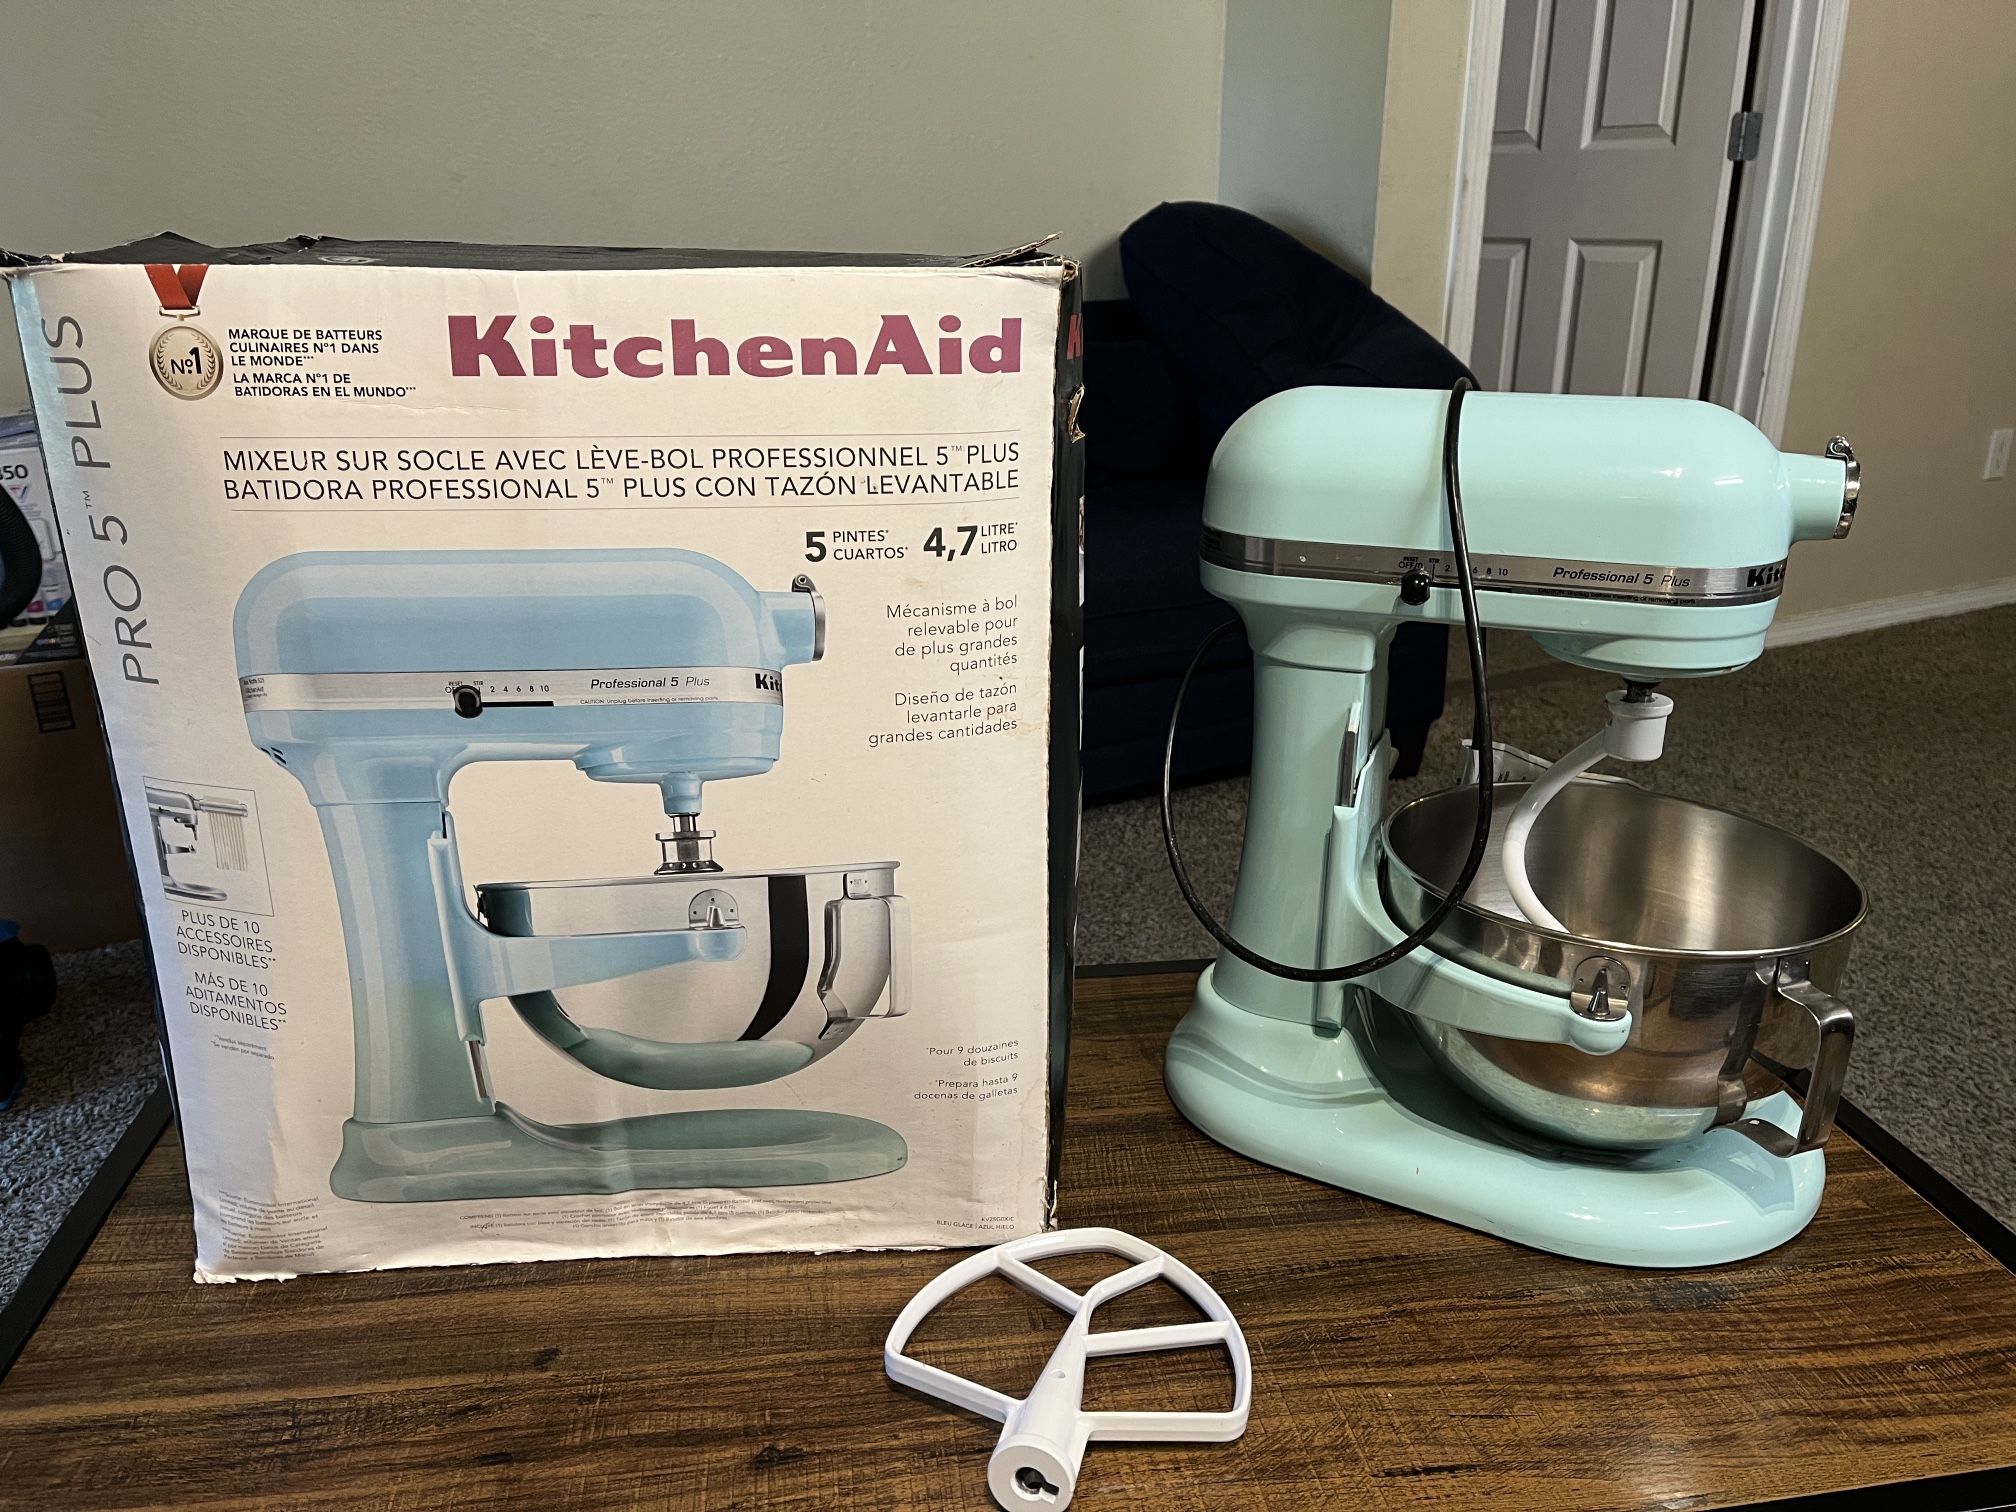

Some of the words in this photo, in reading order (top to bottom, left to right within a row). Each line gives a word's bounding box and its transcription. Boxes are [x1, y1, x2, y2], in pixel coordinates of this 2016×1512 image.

[228, 329, 289, 340] MARQUE
[294, 329, 312, 340] DE
[316, 329, 382, 341] BATTEURS
[229, 342, 309, 353] CULINAIRES
[341, 343, 379, 354] DANS
[447, 314, 1022, 379] KitchenAid
[231, 356, 246, 366] LE
[233, 373, 250, 383] LA
[252, 373, 301, 384] MARCA
[333, 374, 351, 384] DE
[41, 316, 111, 468] PLUS
[235, 386, 308, 397] BATIDORAS
[313, 387, 331, 397] EN
[335, 387, 350, 397] EL
[223, 450, 328, 471] MIXEUR
[337, 449, 389, 471] SUR
[397, 449, 485, 471] SOCLE
[495, 449, 567, 471] AVEC
[576, 444, 704, 470] LÈVE-BOL
[713, 446, 929, 470] PROFESSIONNEL
[967, 442, 1020, 463] PLUS
[223, 478, 364, 500] BATIDORA
[372, 478, 578, 500] PROFESSIONAL
[623, 477, 686, 498] PLUS
[695, 476, 756, 497] CON
[765, 471, 857, 497] TAZÓN
[866, 469, 1019, 495] LEVANTABLE
[805, 531, 827, 562] 5
[923, 525, 978, 561] 4,7
[981, 540, 1017, 554] LITRO
[1498, 568, 1508, 576] 10
[1552, 567, 1639, 585] Professional
[1643, 574, 1655, 585] 5
[1660, 575, 1691, 588] Plus
[886, 602, 977, 619] Mécanisme
[982, 598, 991, 612] à
[995, 594, 1017, 611] bol
[104, 565, 159, 685] PRO
[908, 620, 980, 637] relevable
[985, 616, 1018, 638] pour
[894, 643, 916, 657] de
[921, 641, 954, 660] plus
[959, 634, 1018, 655] grandes
[950, 653, 1018, 675] quantités
[490, 685, 495, 693] 2
[541, 685, 550, 693] 10
[590, 677, 666, 689] Professional
[670, 677, 679, 687] 5
[685, 677, 710, 687] Plus
[894, 691, 950, 707] Diseño
[955, 687, 974, 702] de
[979, 682, 1017, 699] tazón
[907, 705, 981, 724] levantarle
[986, 701, 1017, 720] para
[868, 729, 933, 748] grandes
[938, 718, 1017, 740] cantidades
[181, 909, 215, 927] PLUS
[220, 916, 240, 930] DE
[243, 920, 260, 934] 10
[176, 926, 273, 953] ACCESSOIRES
[195, 971, 225, 988] MÁS
[228, 978, 248, 992] DE
[252, 983, 268, 997] 10
[186, 985, 287, 1015] ADITAMENTOS
[957, 1046, 964, 1055] 9
[967, 1039, 1019, 1054] douzaines
[963, 1057, 978, 1067] de
[981, 1052, 1019, 1065] biscuits
[982, 1075, 1009, 1087] hasta
[1011, 1072, 1019, 1082] 9
[913, 1092, 959, 1100] docenas
[961, 1091, 976, 1100] de
[978, 1086, 1018, 1101] galletas
